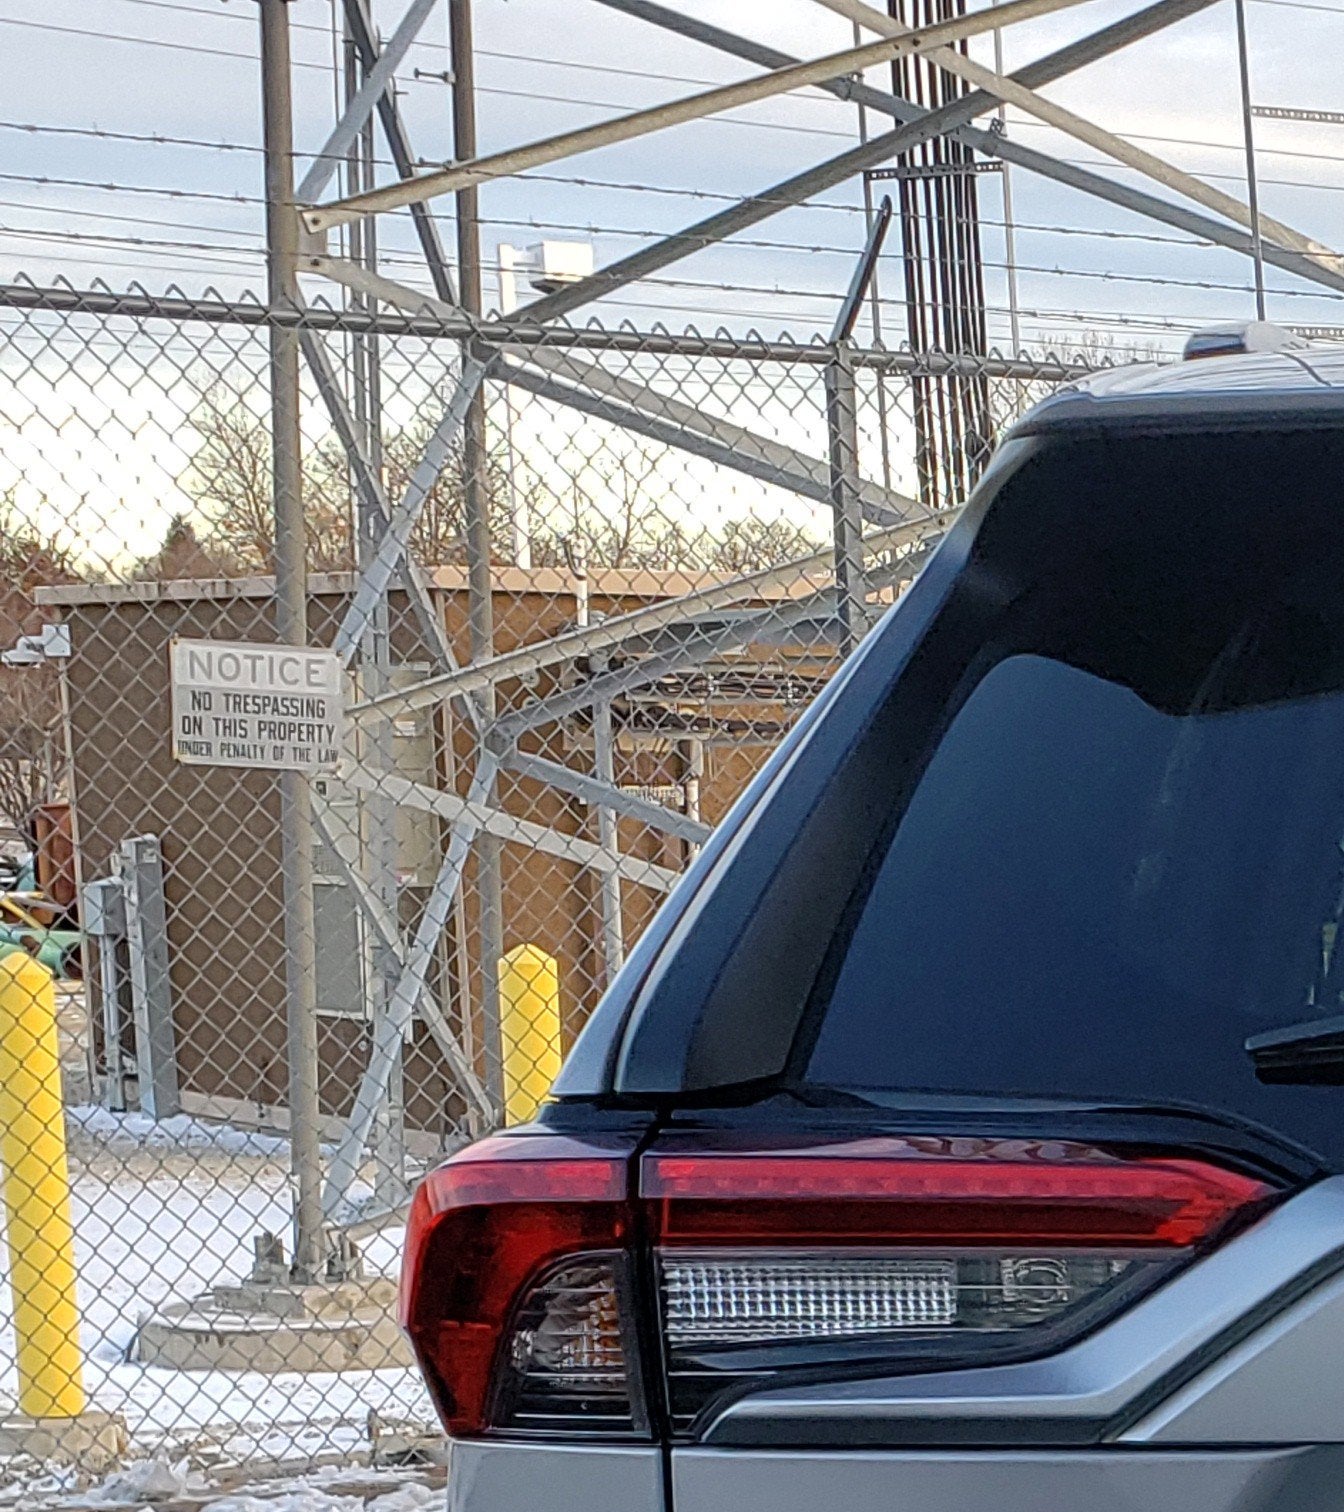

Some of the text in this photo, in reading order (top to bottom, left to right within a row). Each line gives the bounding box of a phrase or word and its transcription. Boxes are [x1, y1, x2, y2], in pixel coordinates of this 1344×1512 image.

[188, 650, 328, 687] NOTICE
[191, 690, 326, 719] NO TRESPASSING
[181, 716, 335, 744] ON THIS PROPERTY
[178, 740, 338, 764] UNDER PENALTY OF THE LAW
